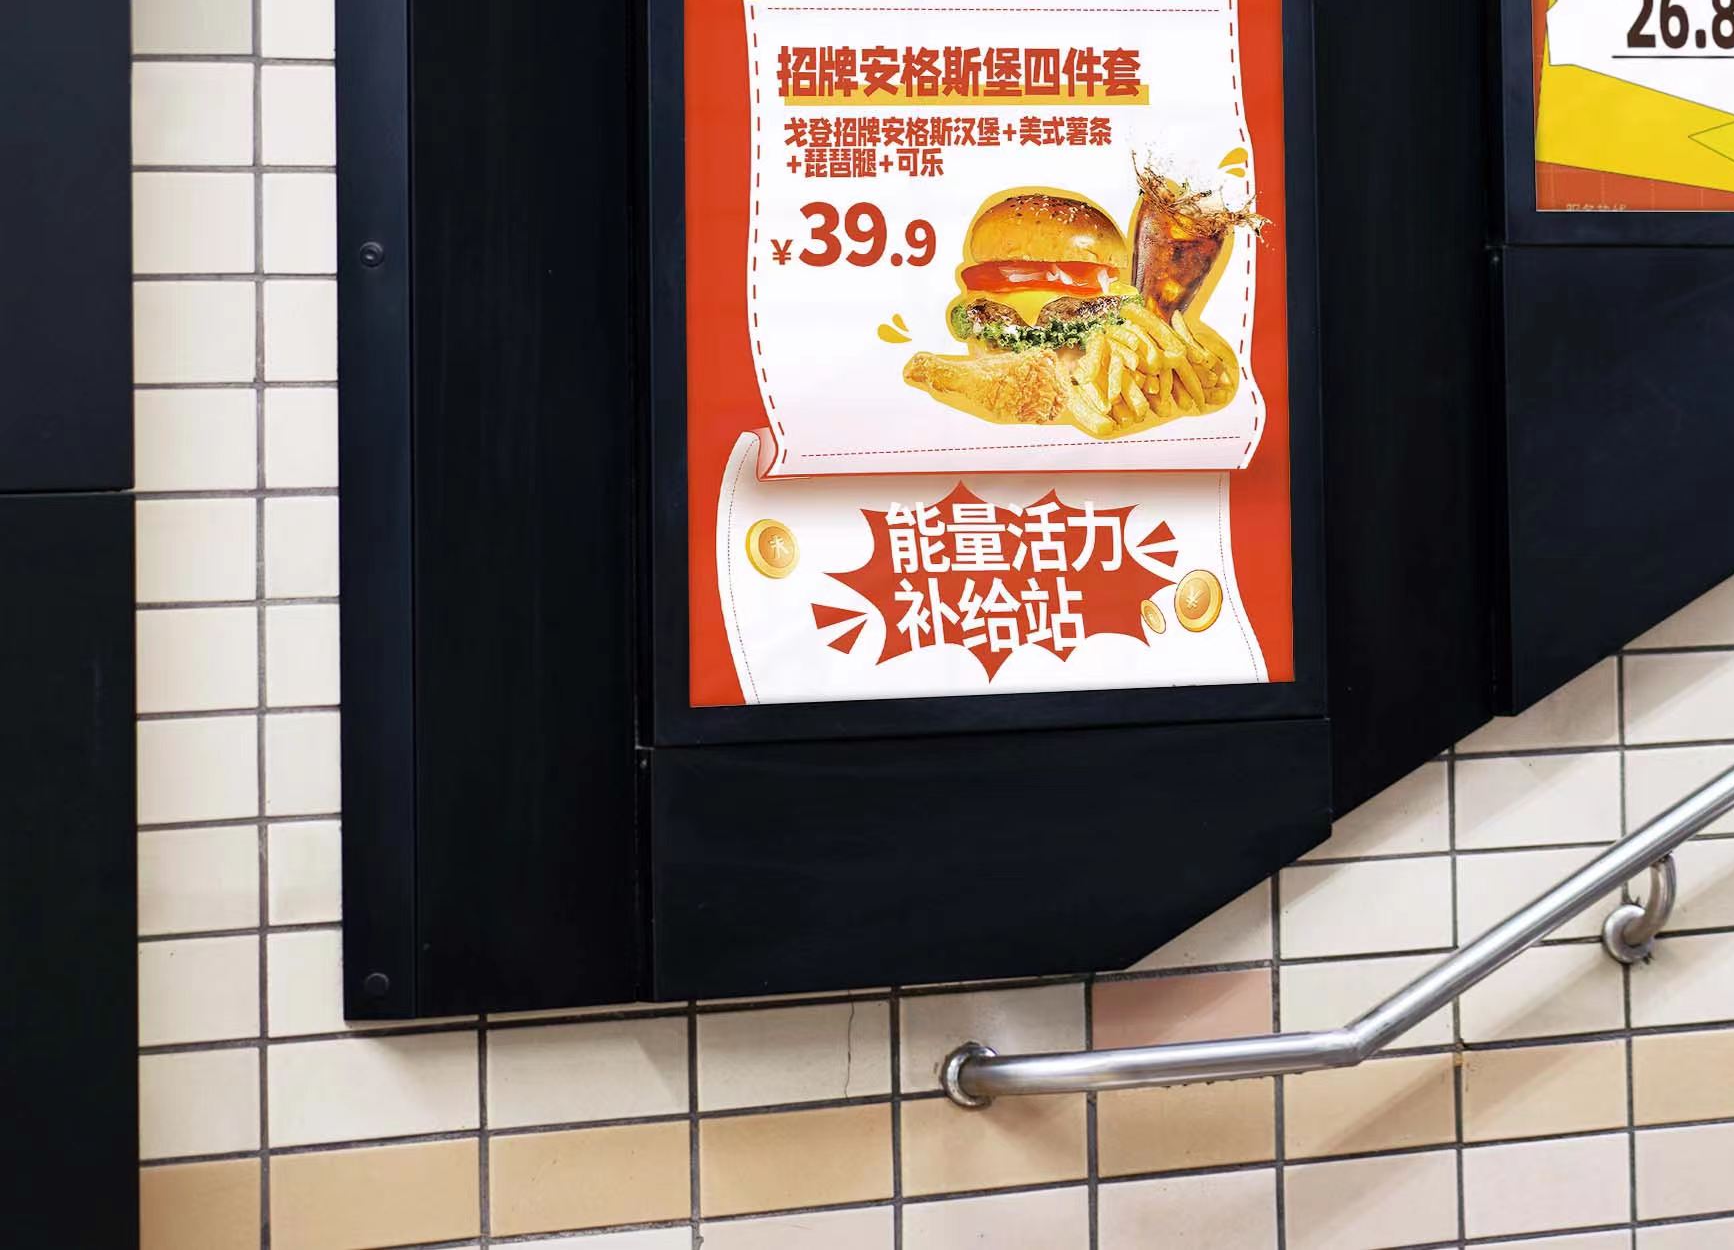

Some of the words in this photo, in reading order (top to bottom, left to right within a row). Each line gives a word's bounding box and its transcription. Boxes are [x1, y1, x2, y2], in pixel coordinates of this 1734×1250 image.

[777, 45, 1142, 98] 招牌安格斯堡四件套
[784, 116, 1113, 148] 戈登招牌安格斯汉堡+美式薯条
[786, 147, 945, 178] +琵琶腿+可乐
[886, 501, 1123, 574] 能量活力
[895, 576, 1085, 653] 补给站
